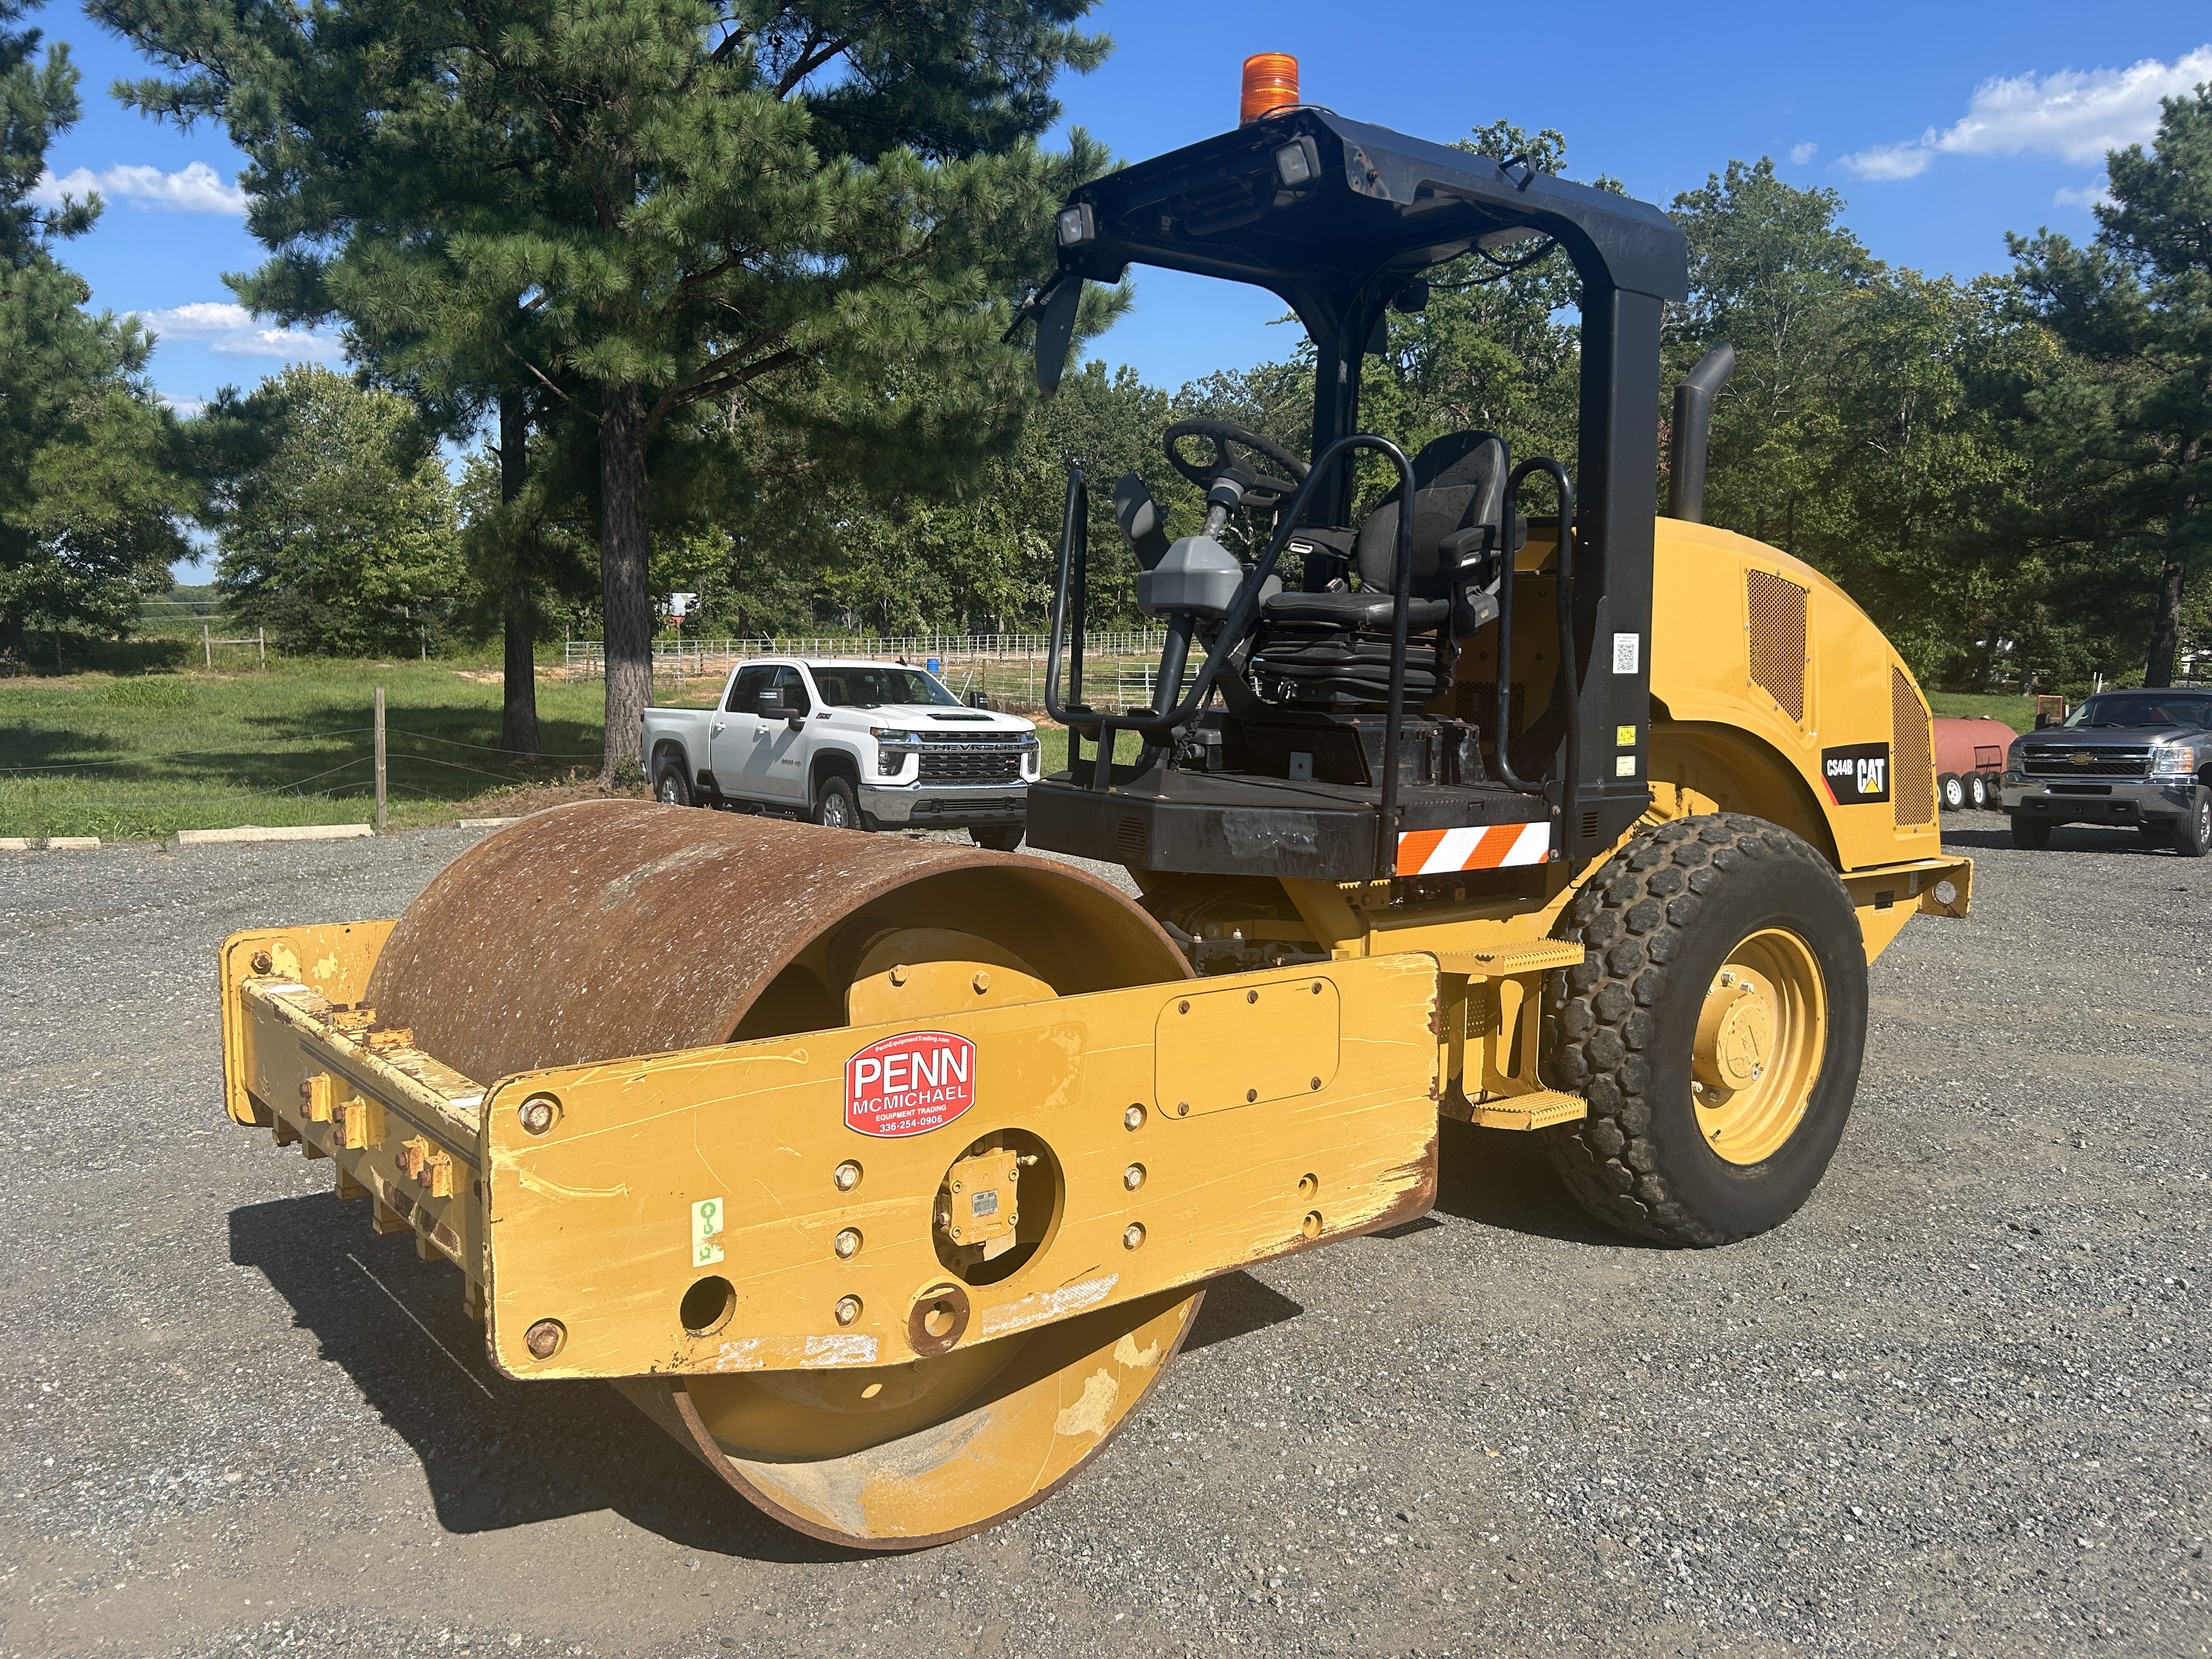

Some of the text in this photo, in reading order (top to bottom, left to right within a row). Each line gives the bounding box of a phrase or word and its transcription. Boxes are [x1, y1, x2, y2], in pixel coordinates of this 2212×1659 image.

[1827, 758, 1884, 794] CS44B CAT
[875, 1035, 950, 1052] PennEquipmentTrading.com
[854, 1045, 968, 1099] PENN
[853, 1085, 968, 1115] MCMICHAEL
[876, 1104, 947, 1122] EQUIPMENT TRADING
[879, 1114, 943, 1133] 336-254-0906
